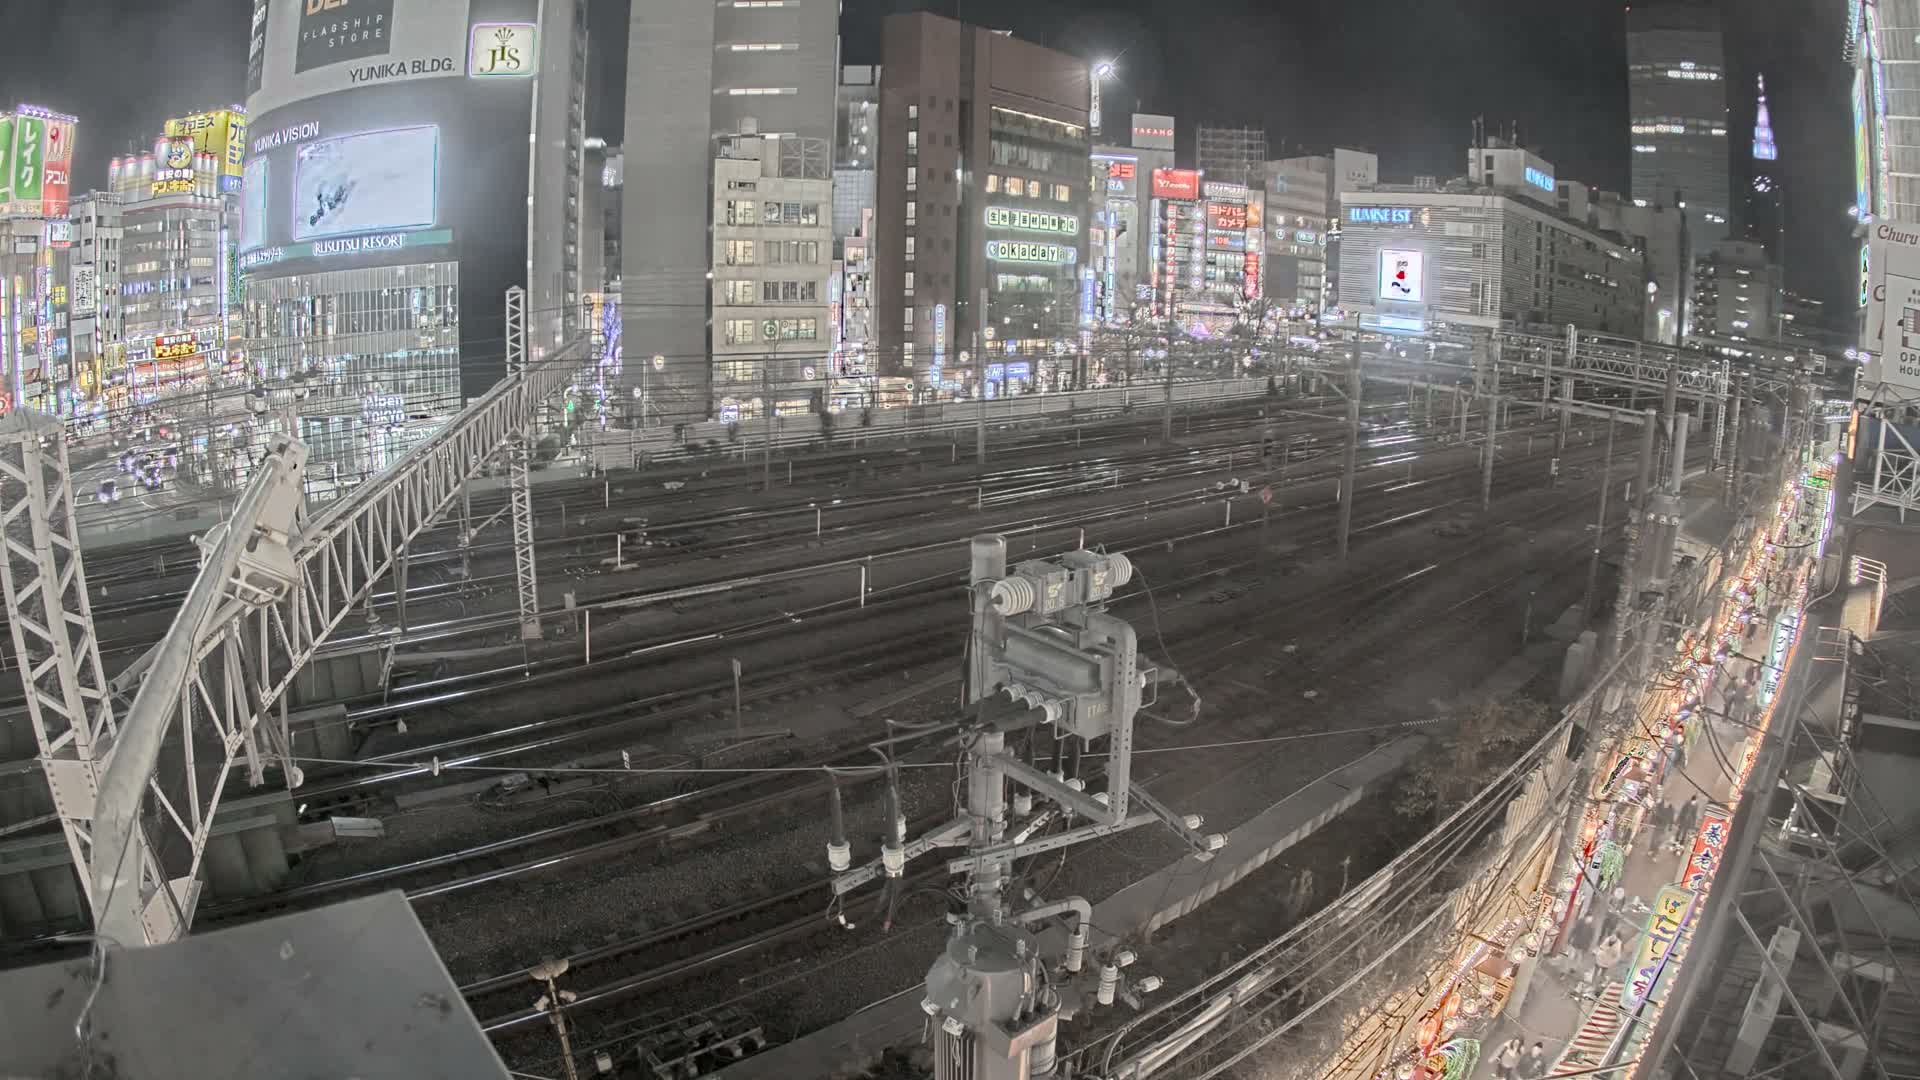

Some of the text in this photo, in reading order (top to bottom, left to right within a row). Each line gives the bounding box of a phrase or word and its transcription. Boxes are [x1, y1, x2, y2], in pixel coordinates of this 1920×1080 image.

[303, 14, 383, 42] FLAGSHIP
[328, 28, 382, 48] STORE
[349, 57, 456, 83] YUNIKA BLDG.
[177, 117, 215, 134] プロミス
[1133, 127, 1174, 137] TAKANO
[255, 121, 320, 154] YUNIKA VISION
[20, 121, 37, 188] レイク
[45, 169, 68, 185] アコム
[1208, 205, 1246, 217] ヨドバシ
[1218, 218, 1246, 229] カメラ
[312, 232, 407, 257] RUSUTSU RESORT
[1877, 224, 1919, 245] Churu
[1000, 245, 1067, 260] okadaya
